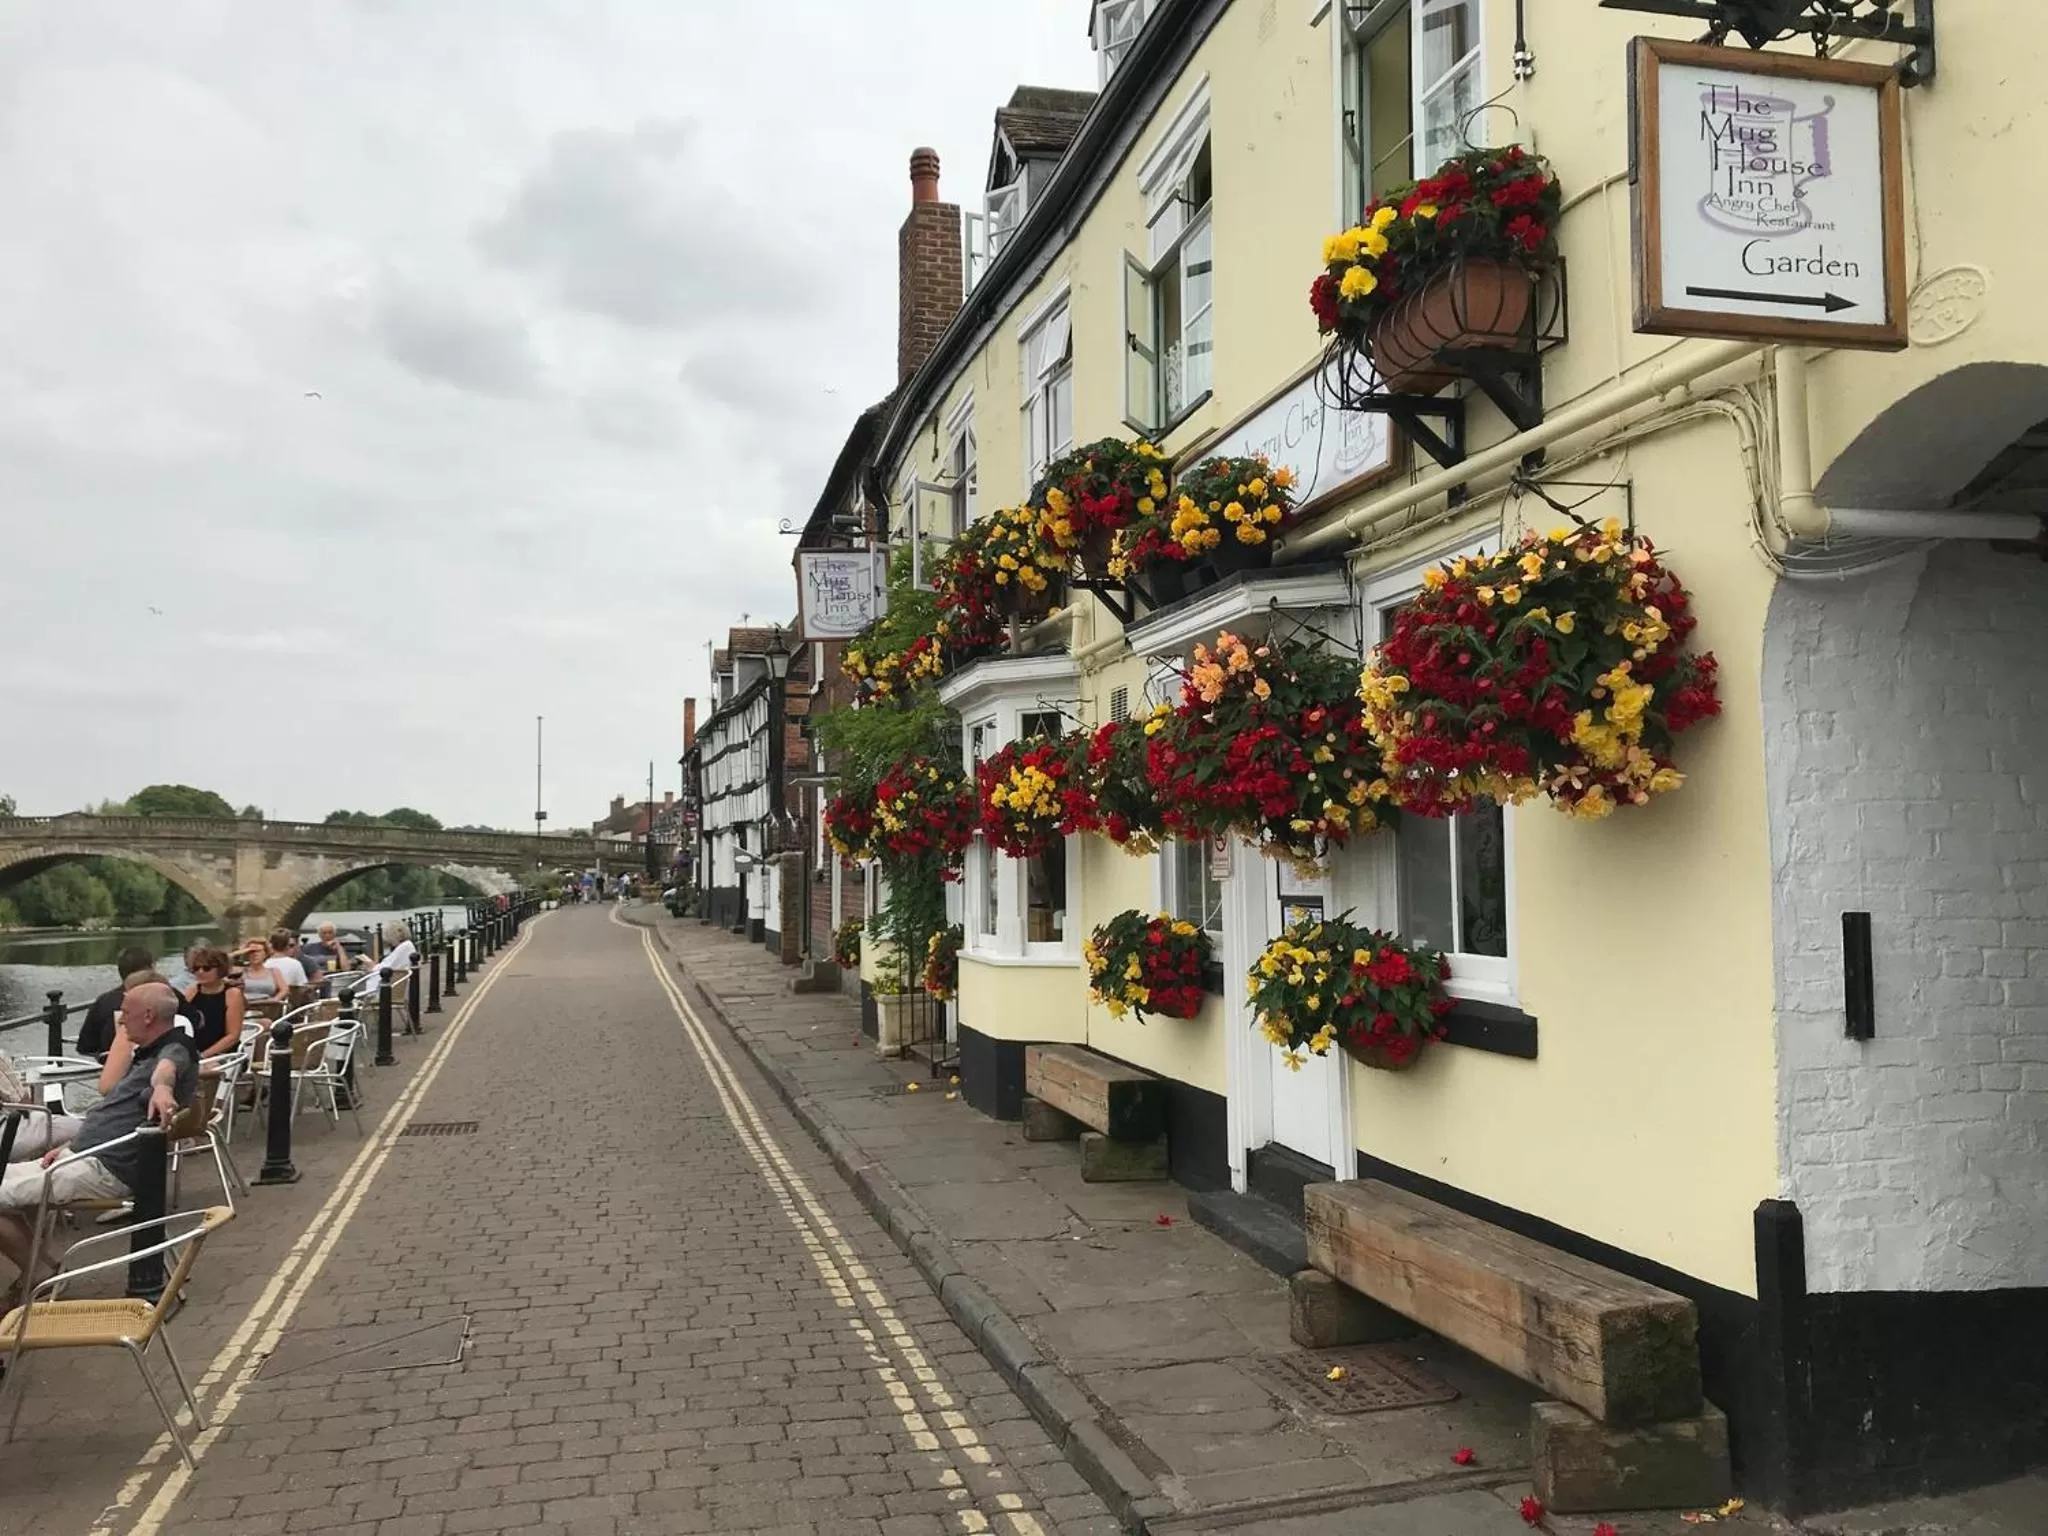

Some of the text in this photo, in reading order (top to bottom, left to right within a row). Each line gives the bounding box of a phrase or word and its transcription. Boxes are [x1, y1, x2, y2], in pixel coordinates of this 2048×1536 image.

[1698, 82, 1771, 115] The
[1701, 111, 1777, 153] Mug
[1714, 141, 1825, 177] House
[1729, 165, 1774, 197] Inn
[1707, 192, 1798, 213] Angry Chef
[1757, 211, 1836, 231] Restaurant
[1742, 238, 1860, 278] Garden
[807, 556, 847, 573] The
[809, 571, 850, 590] Mug
[824, 597, 849, 616] Inn
